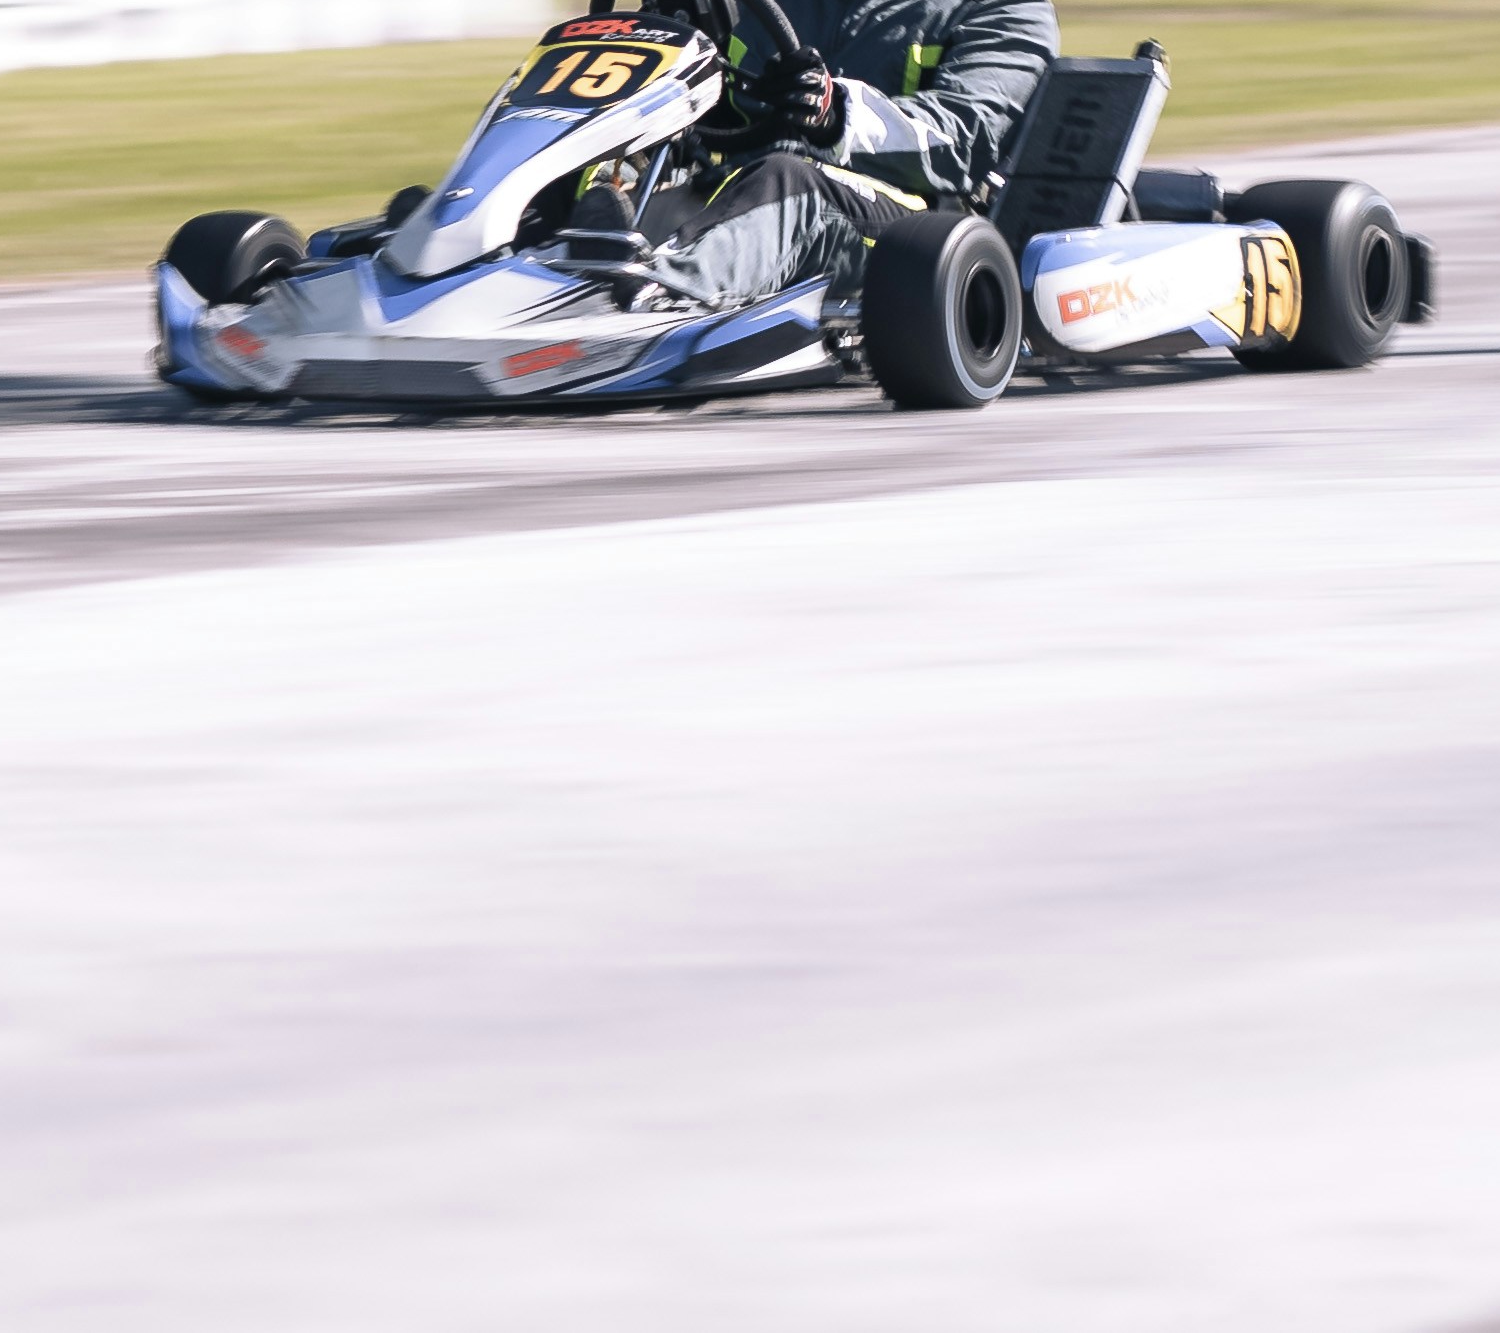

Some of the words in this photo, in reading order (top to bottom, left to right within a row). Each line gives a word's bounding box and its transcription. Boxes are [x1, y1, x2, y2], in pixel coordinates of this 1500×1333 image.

[535, 50, 648, 99] 15
[1057, 275, 1137, 326] DZK
[1246, 238, 1294, 337] 15
